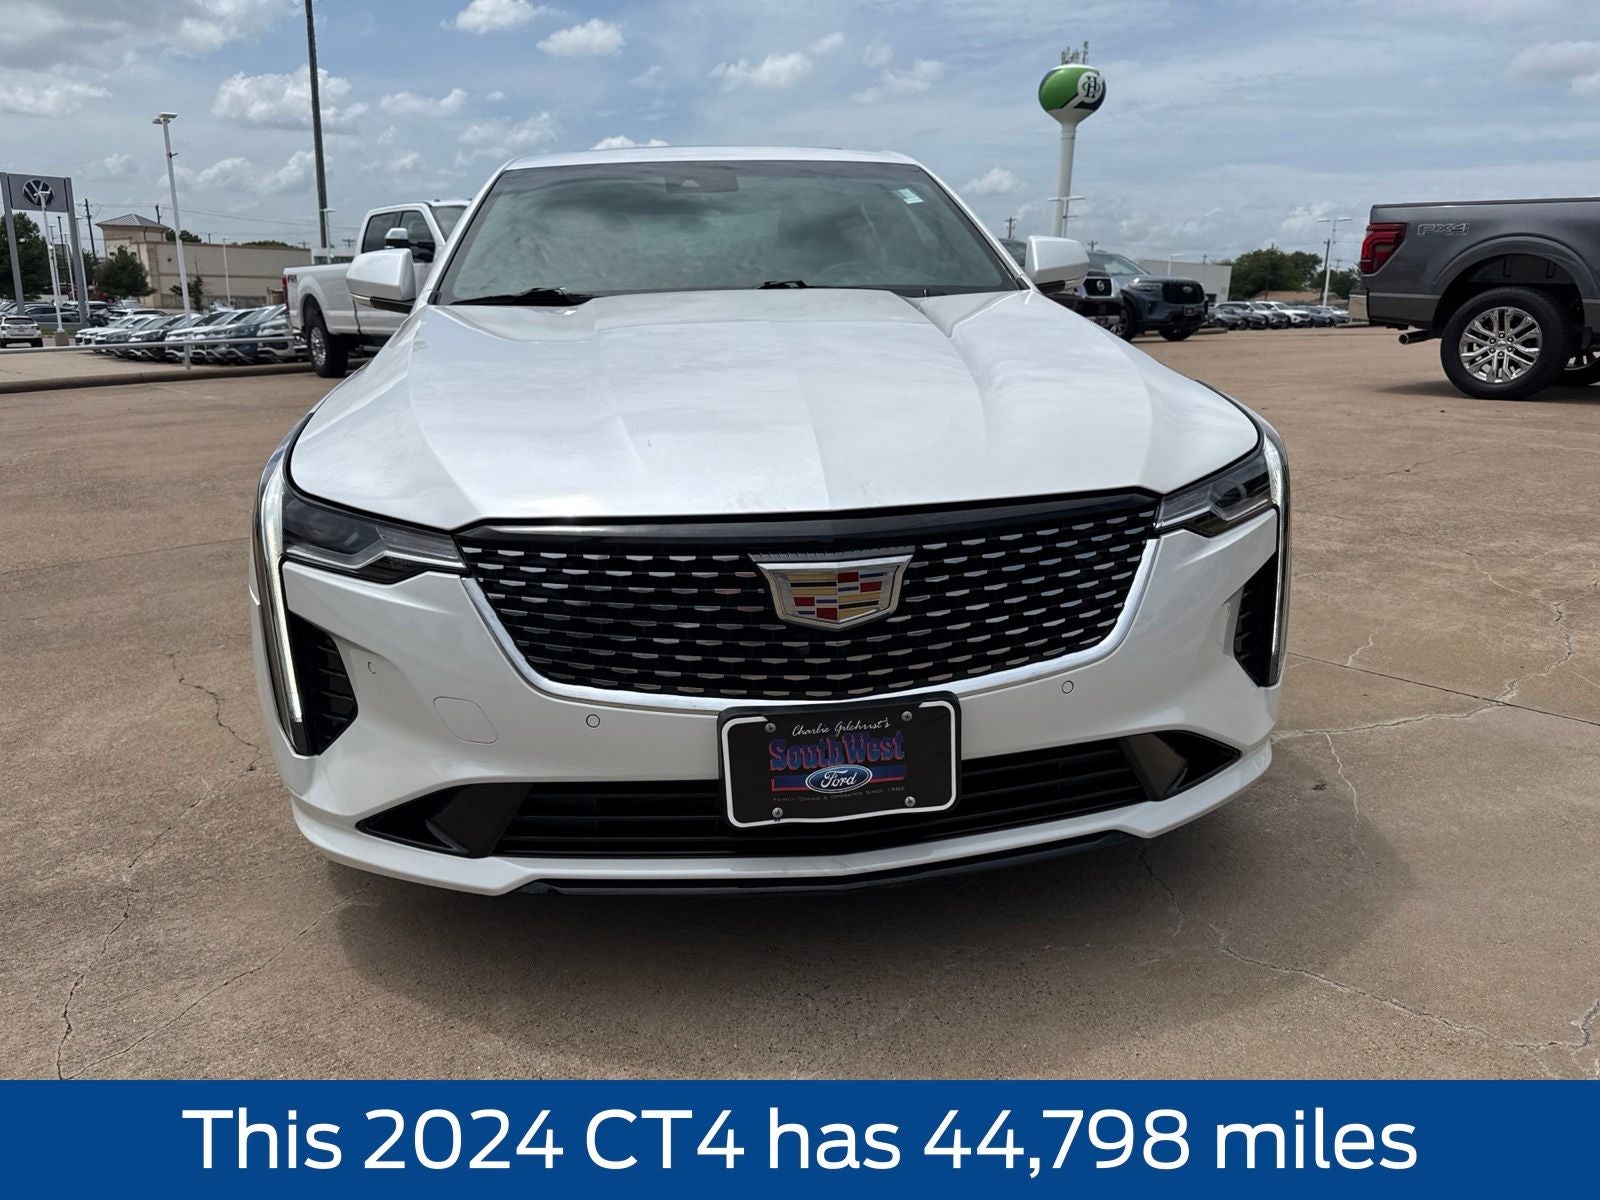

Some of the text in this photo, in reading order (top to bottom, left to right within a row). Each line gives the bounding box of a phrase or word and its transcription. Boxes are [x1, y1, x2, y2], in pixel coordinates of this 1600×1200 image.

[1417, 223, 1470, 238] FX4
[792, 723, 830, 737] Charlie
[820, 769, 857, 788] Ford
